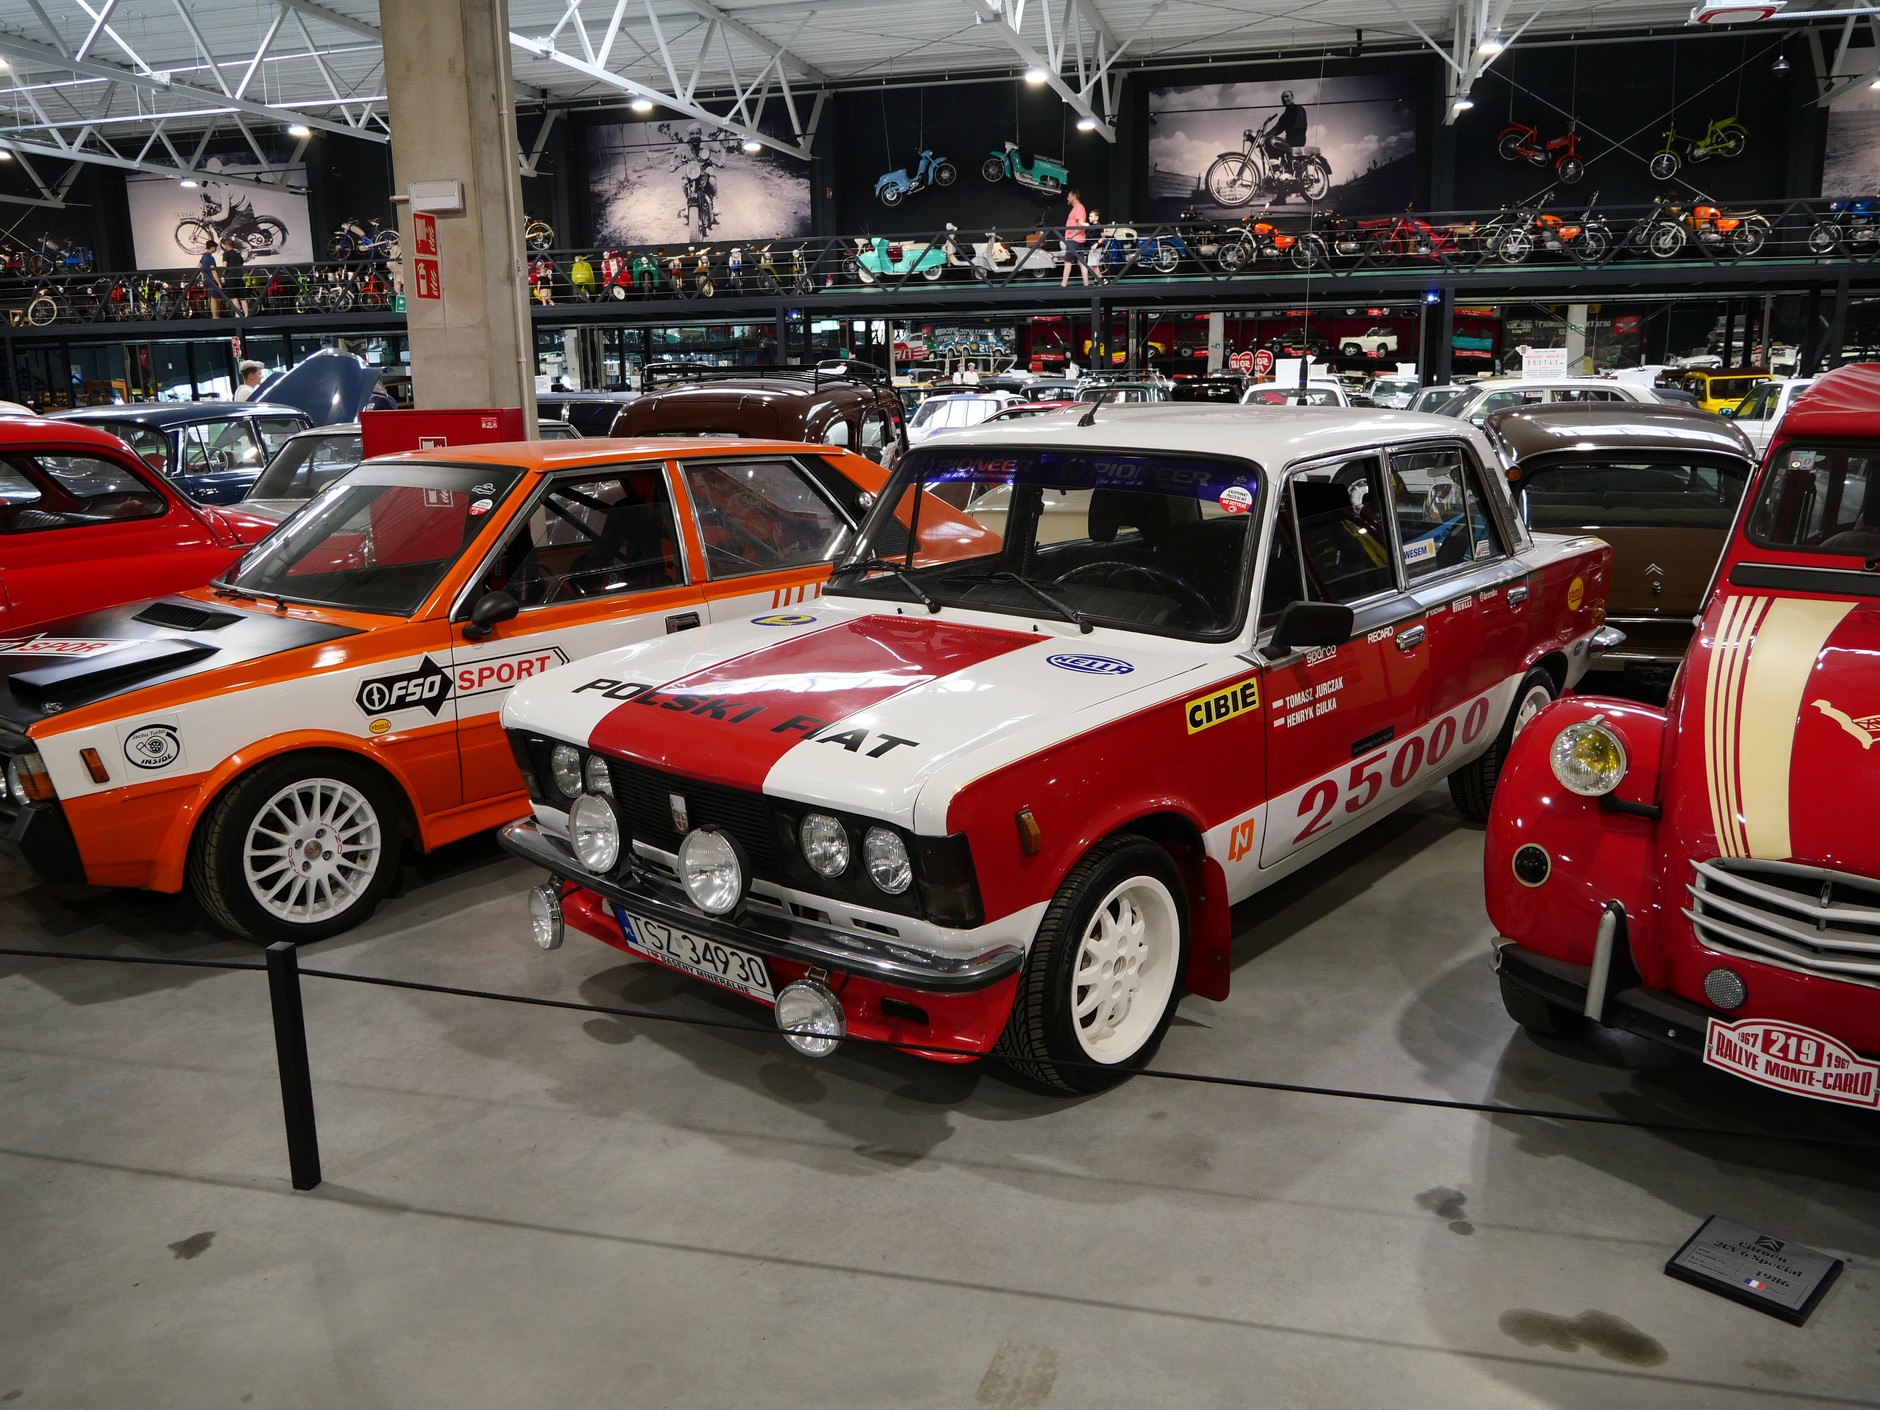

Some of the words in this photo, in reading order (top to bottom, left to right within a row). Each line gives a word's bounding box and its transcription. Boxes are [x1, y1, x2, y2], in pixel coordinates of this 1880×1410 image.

[250, 234, 263, 246] 29
[937, 458, 1034, 472] PIONEER
[1094, 462, 1212, 486] PIONEER
[1403, 545, 1428, 560] WESEM
[1429, 605, 1446, 618] YOKOHAMA
[1452, 596, 1472, 613] PIRELLI
[1368, 626, 1394, 644] RECARO
[1053, 655, 1131, 676] HELLA
[1306, 645, 1337, 666] sparco
[389, 674, 442, 706] FSO
[458, 656, 550, 691] SPORT
[1286, 688, 1314, 710] TOMASZ
[1315, 676, 1344, 698] JURCZAK
[1188, 681, 1257, 729] CIBIÉ
[1286, 706, 1314, 728] HENRYK
[1316, 697, 1337, 716] GULKA
[571, 678, 764, 724] POLSKI
[770, 714, 920, 758] FIAT
[141, 753, 173, 764] INSIDE
[1292, 697, 1490, 845] 25000
[624, 926, 634, 937] PL
[626, 914, 681, 958] TSZ
[681, 934, 768, 988] 34930
[660, 955, 694, 974] BASENY
[696, 968, 751, 994] MINERALNE
[1737, 1031, 1760, 1048] 1967
[1768, 1031, 1818, 1065] 219
[1826, 1052, 1850, 1070] 1967
[1716, 1030, 1760, 1072] RALLYE
[1764, 1059, 1873, 1097] MONTE-CARLO
[1713, 1240, 1738, 1254] 2CV
[1751, 1254, 1803, 1278] Special
[1738, 1240, 1788, 1264] Citroën
[1754, 1270, 1790, 1288] 1986
